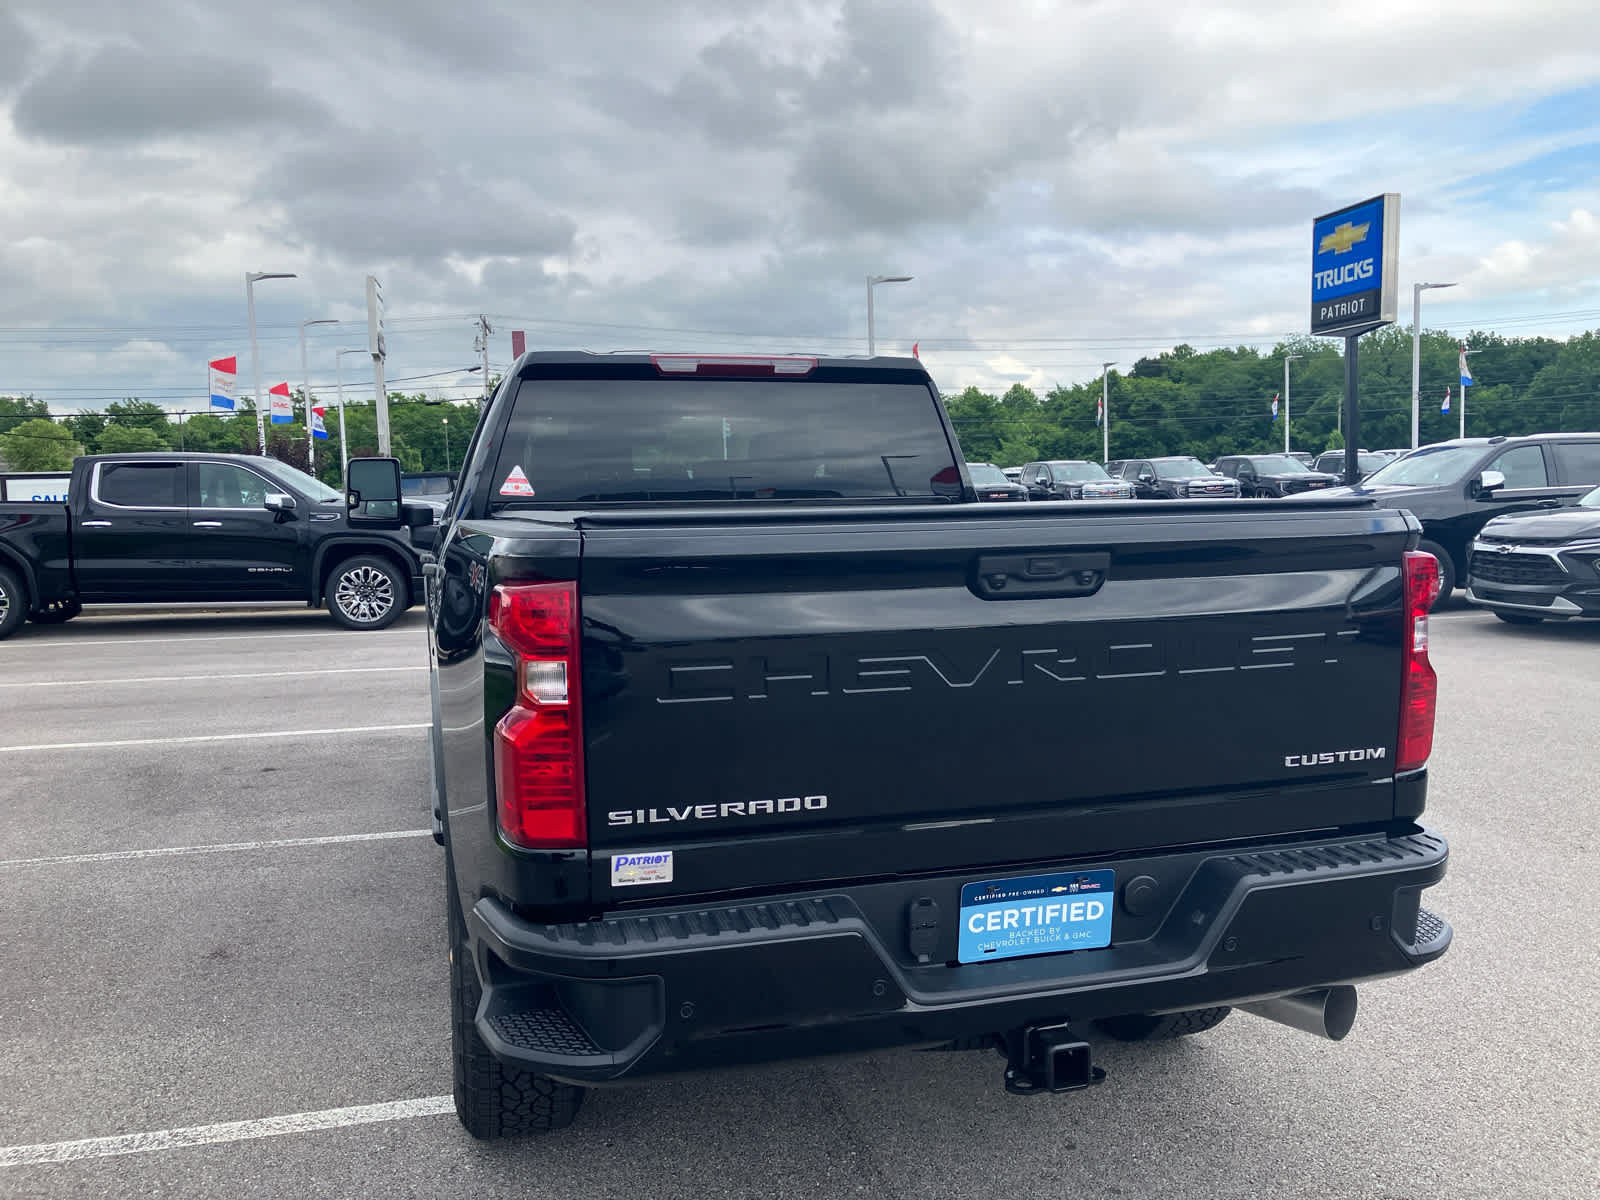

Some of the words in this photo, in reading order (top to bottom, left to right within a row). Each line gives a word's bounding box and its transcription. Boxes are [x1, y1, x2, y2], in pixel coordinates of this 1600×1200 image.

[1314, 257, 1374, 290] TRUCKS
[1320, 298, 1366, 321] PATRIOT
[656, 622, 1361, 704] CHEVROLET
[1284, 747, 1386, 768] CUSTOM
[607, 794, 828, 826] SILVERADO
[973, 893, 1006, 901] CERTIFIED
[1008, 888, 1045, 897] PRE-OWNED
[967, 900, 1104, 933] CERTIFIED
[976, 937, 1031, 952] CHEVROLET
[1033, 933, 1062, 944] BUICK
[1064, 932, 1070, 940] &
[1072, 930, 1093, 940] GMC
[1009, 928, 1046, 938] BACKED
[1049, 927, 1061, 935] BY
